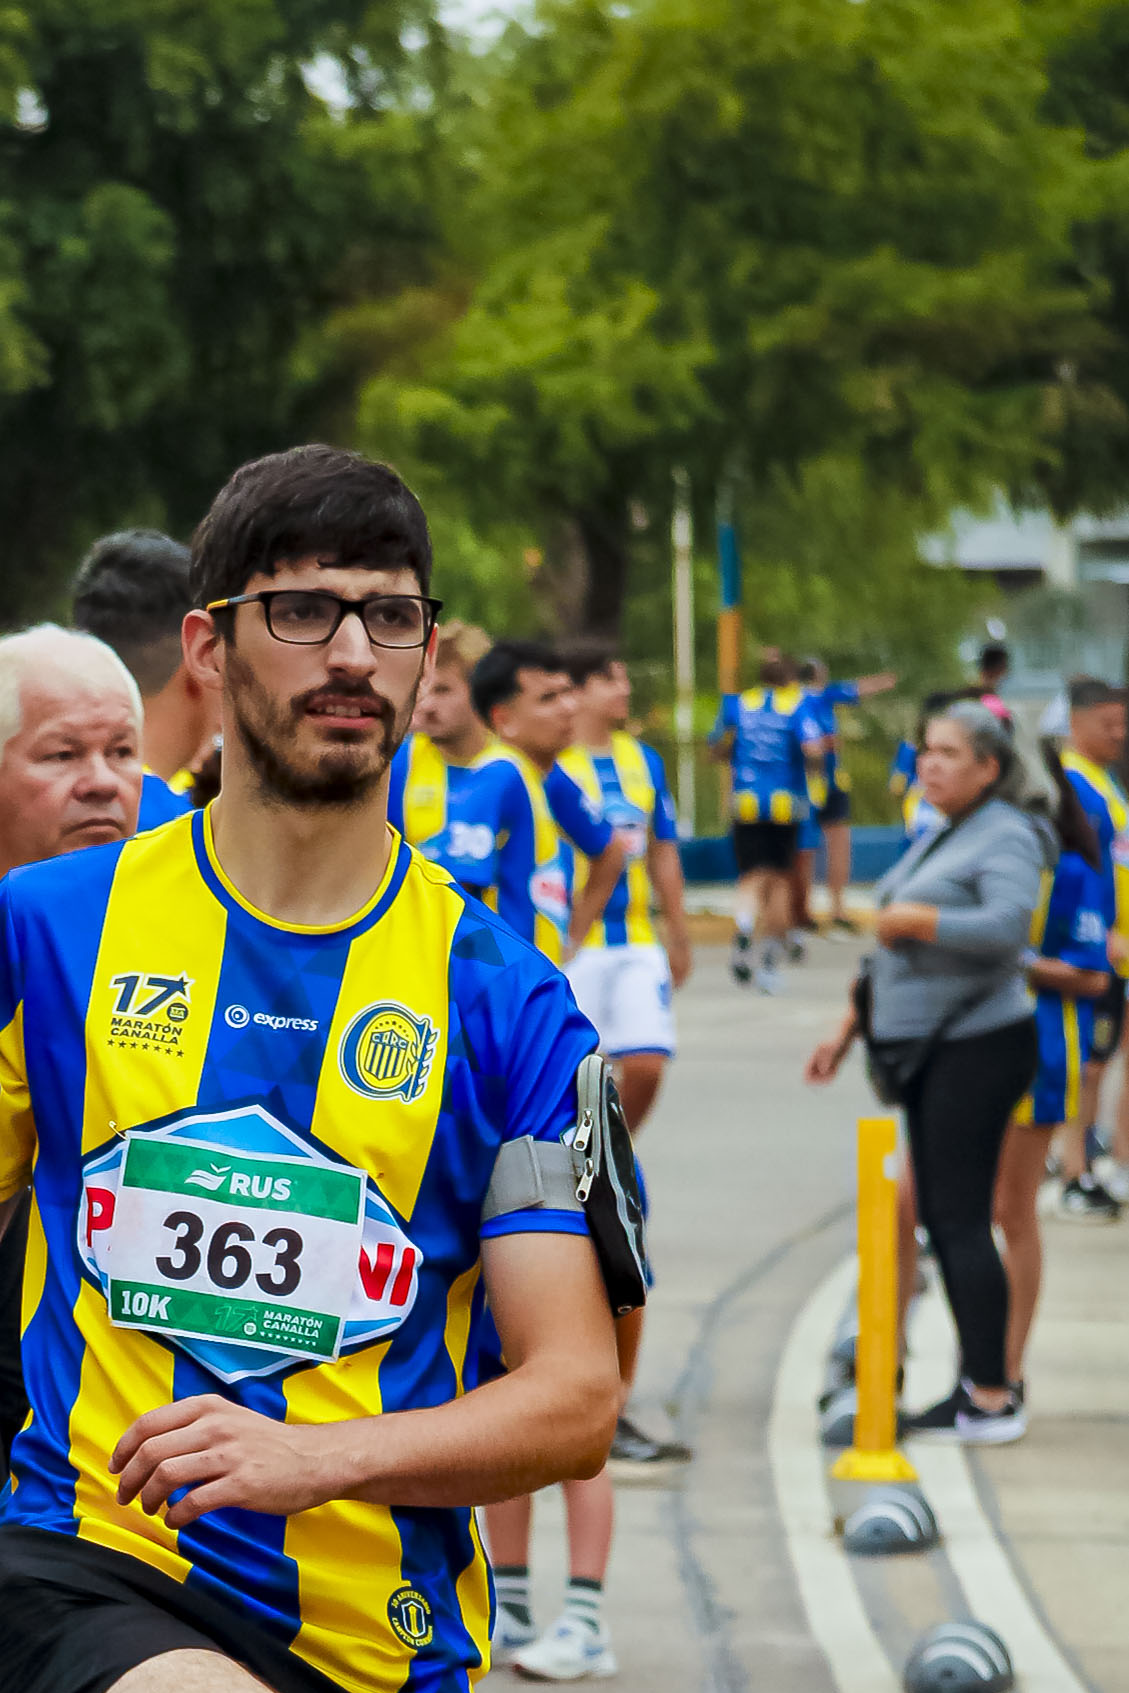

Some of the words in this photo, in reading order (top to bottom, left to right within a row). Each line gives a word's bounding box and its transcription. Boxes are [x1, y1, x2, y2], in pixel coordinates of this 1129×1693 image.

[110, 971, 194, 1018] 17
[111, 1017, 183, 1036] MARATÓN
[253, 1012, 319, 1032] express
[110, 1027, 178, 1045] CANALLA
[230, 1174, 292, 1201] RUS
[155, 1210, 304, 1297] 363
[121, 1290, 172, 1320] 10K
[263, 1310, 323, 1329] MARATÓN
[263, 1320, 320, 1339] CANALLA
